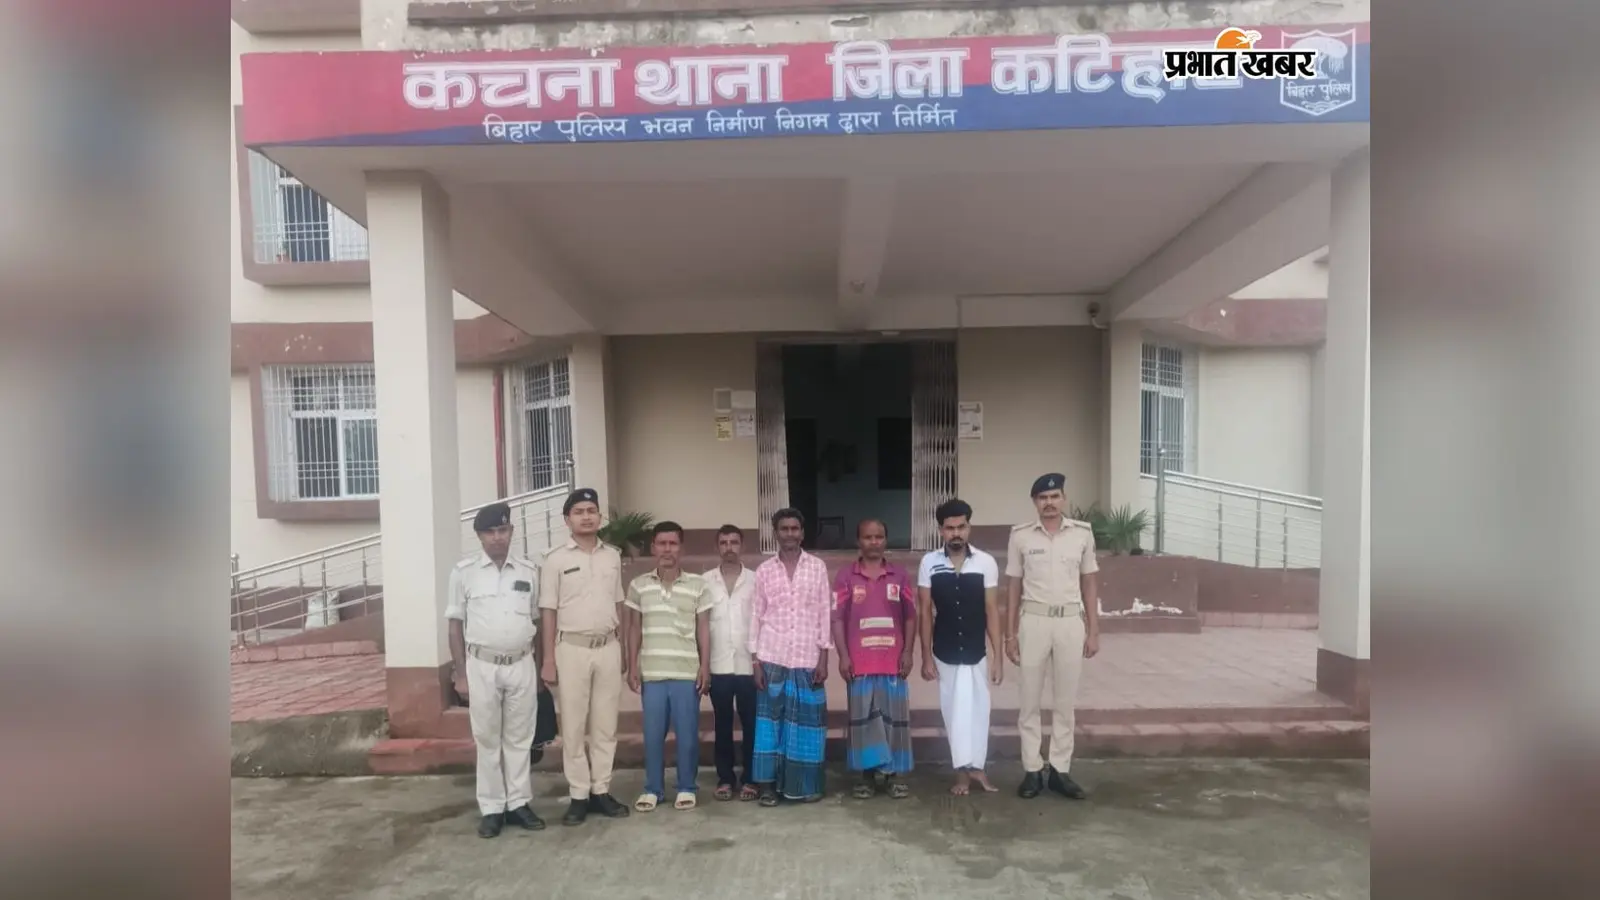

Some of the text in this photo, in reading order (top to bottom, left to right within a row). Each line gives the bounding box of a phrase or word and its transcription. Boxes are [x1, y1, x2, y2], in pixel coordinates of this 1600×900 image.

[403, 34, 1243, 110] कचना थाना जिला कटिह
[1286, 78, 1352, 100] बिहार पुलिस
[481, 103, 958, 144] बिहार पुलिस भवन निर्माण निगम द्वारा निर्मित
